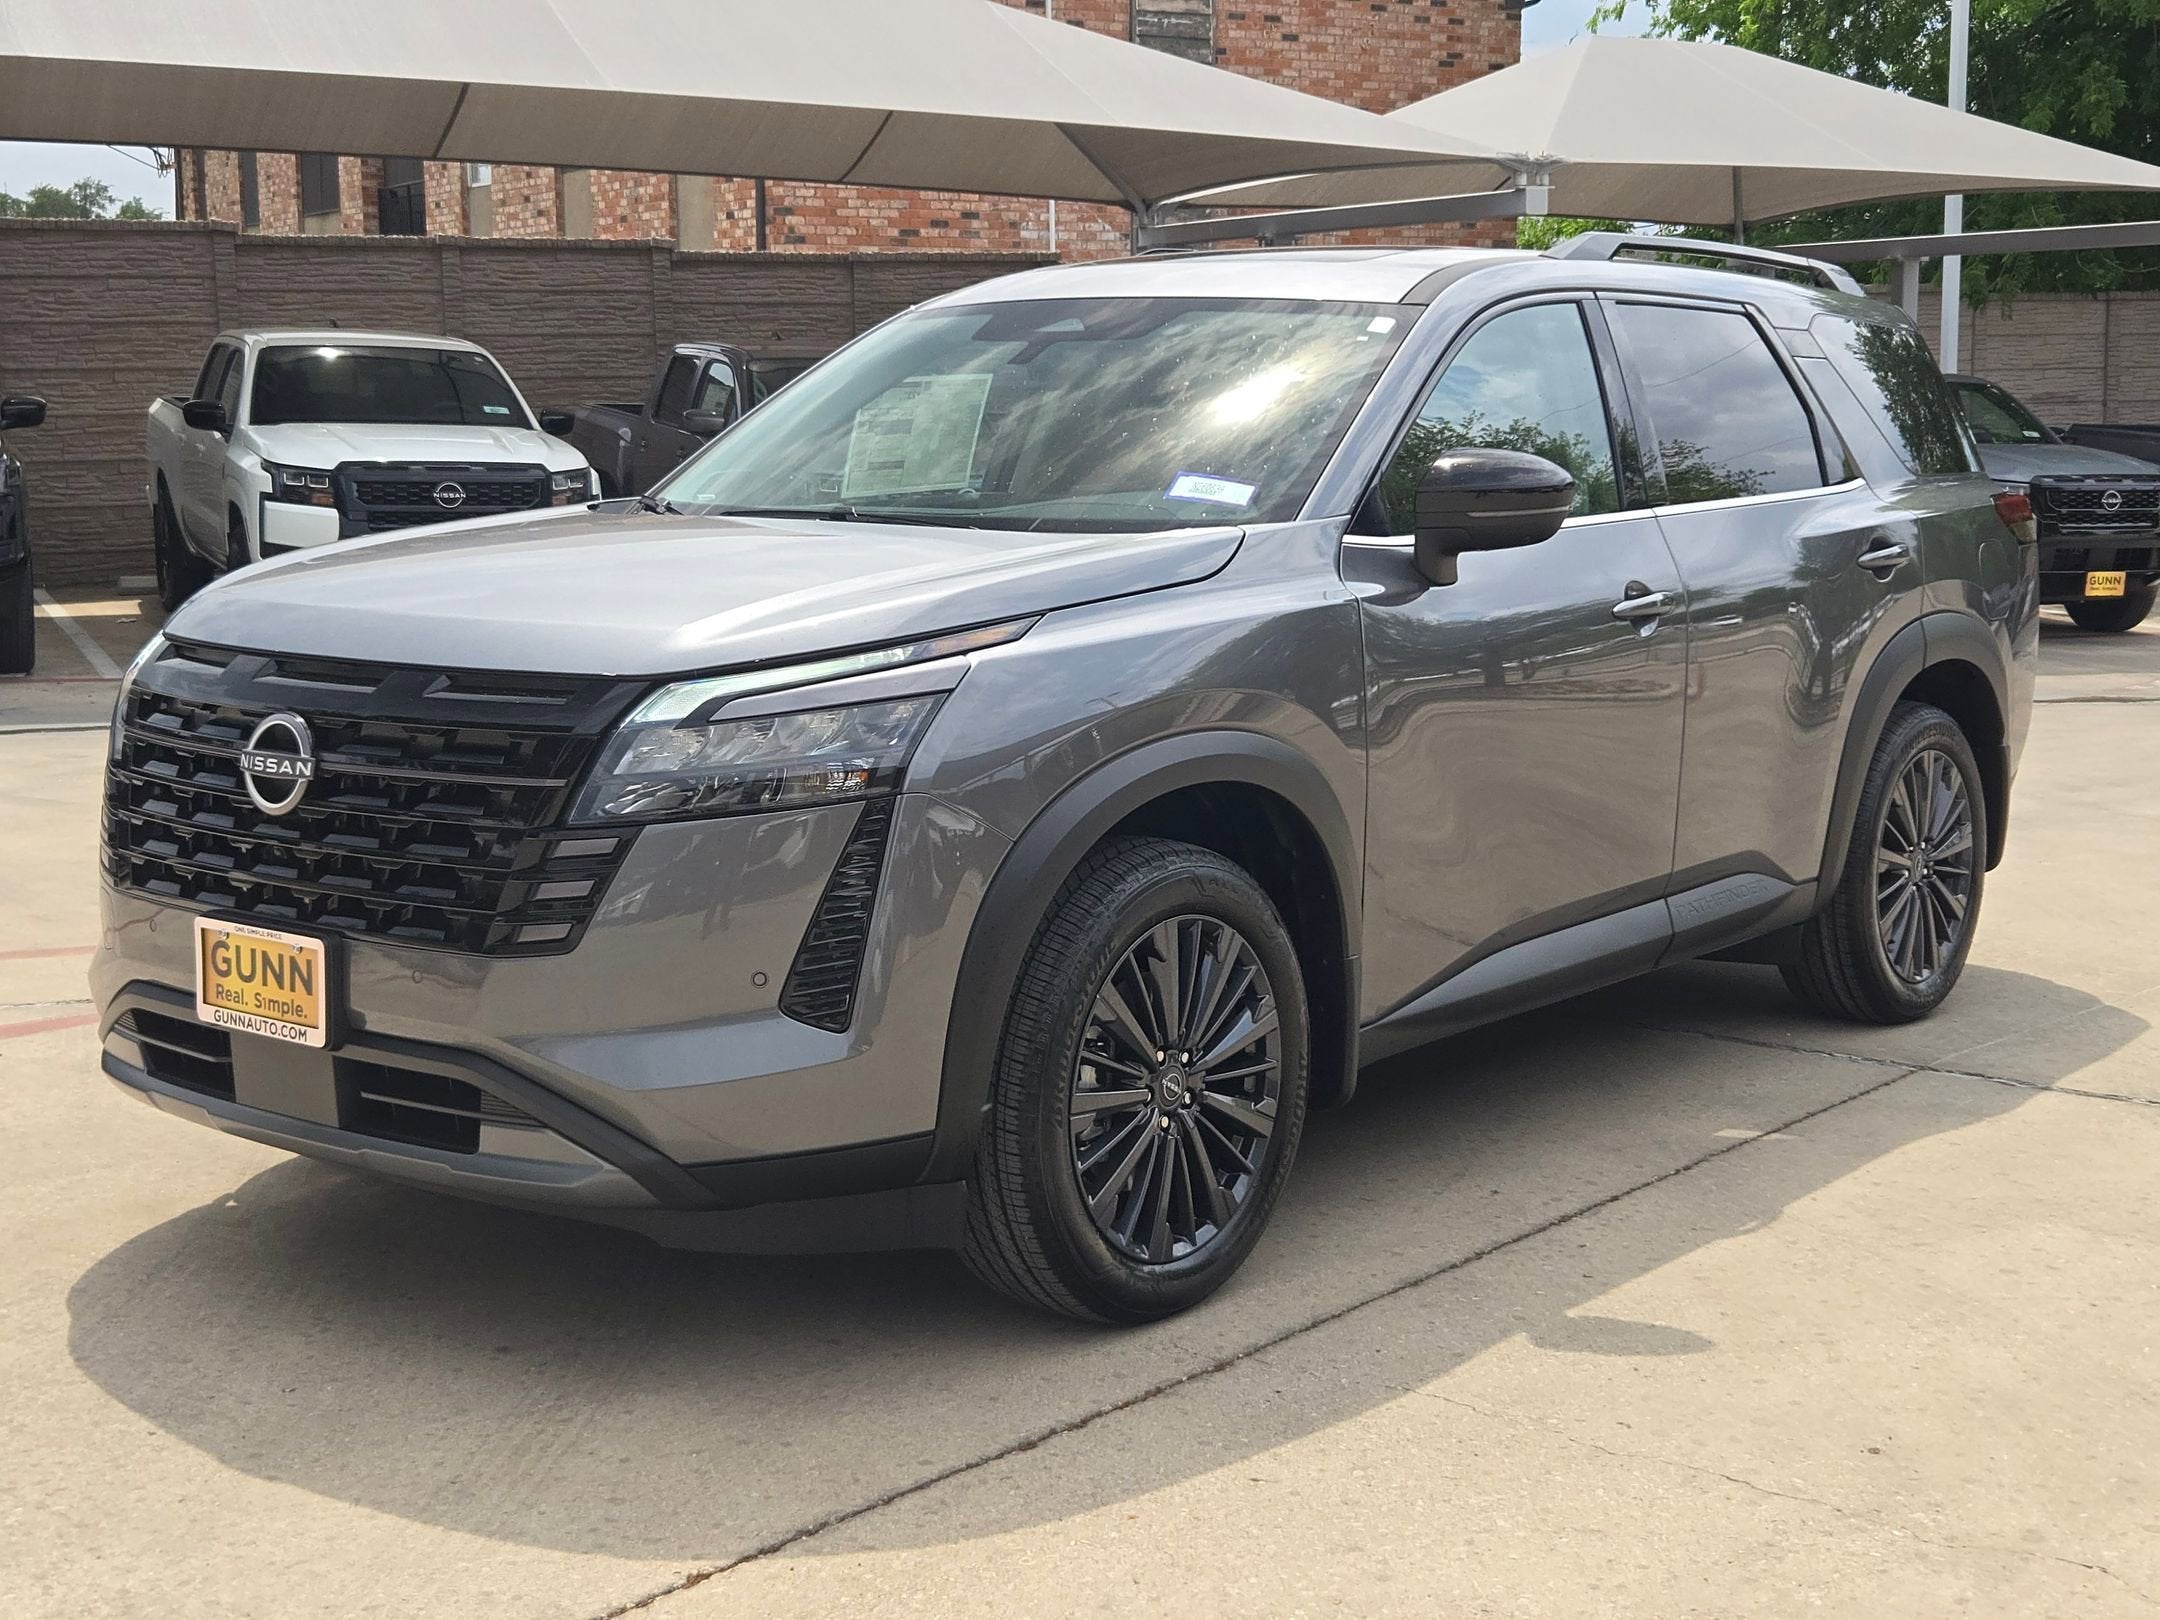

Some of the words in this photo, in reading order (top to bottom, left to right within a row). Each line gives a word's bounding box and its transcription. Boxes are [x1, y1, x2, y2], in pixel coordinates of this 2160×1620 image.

[2089, 576, 2122, 586] GUNN
[240, 753, 312, 776] NISSAN
[1674, 878, 1770, 919] PATHFINDER
[210, 939, 313, 997] GUNN
[215, 983, 249, 1006] Real.
[213, 1009, 308, 1043] GUNNAUTO.COM
